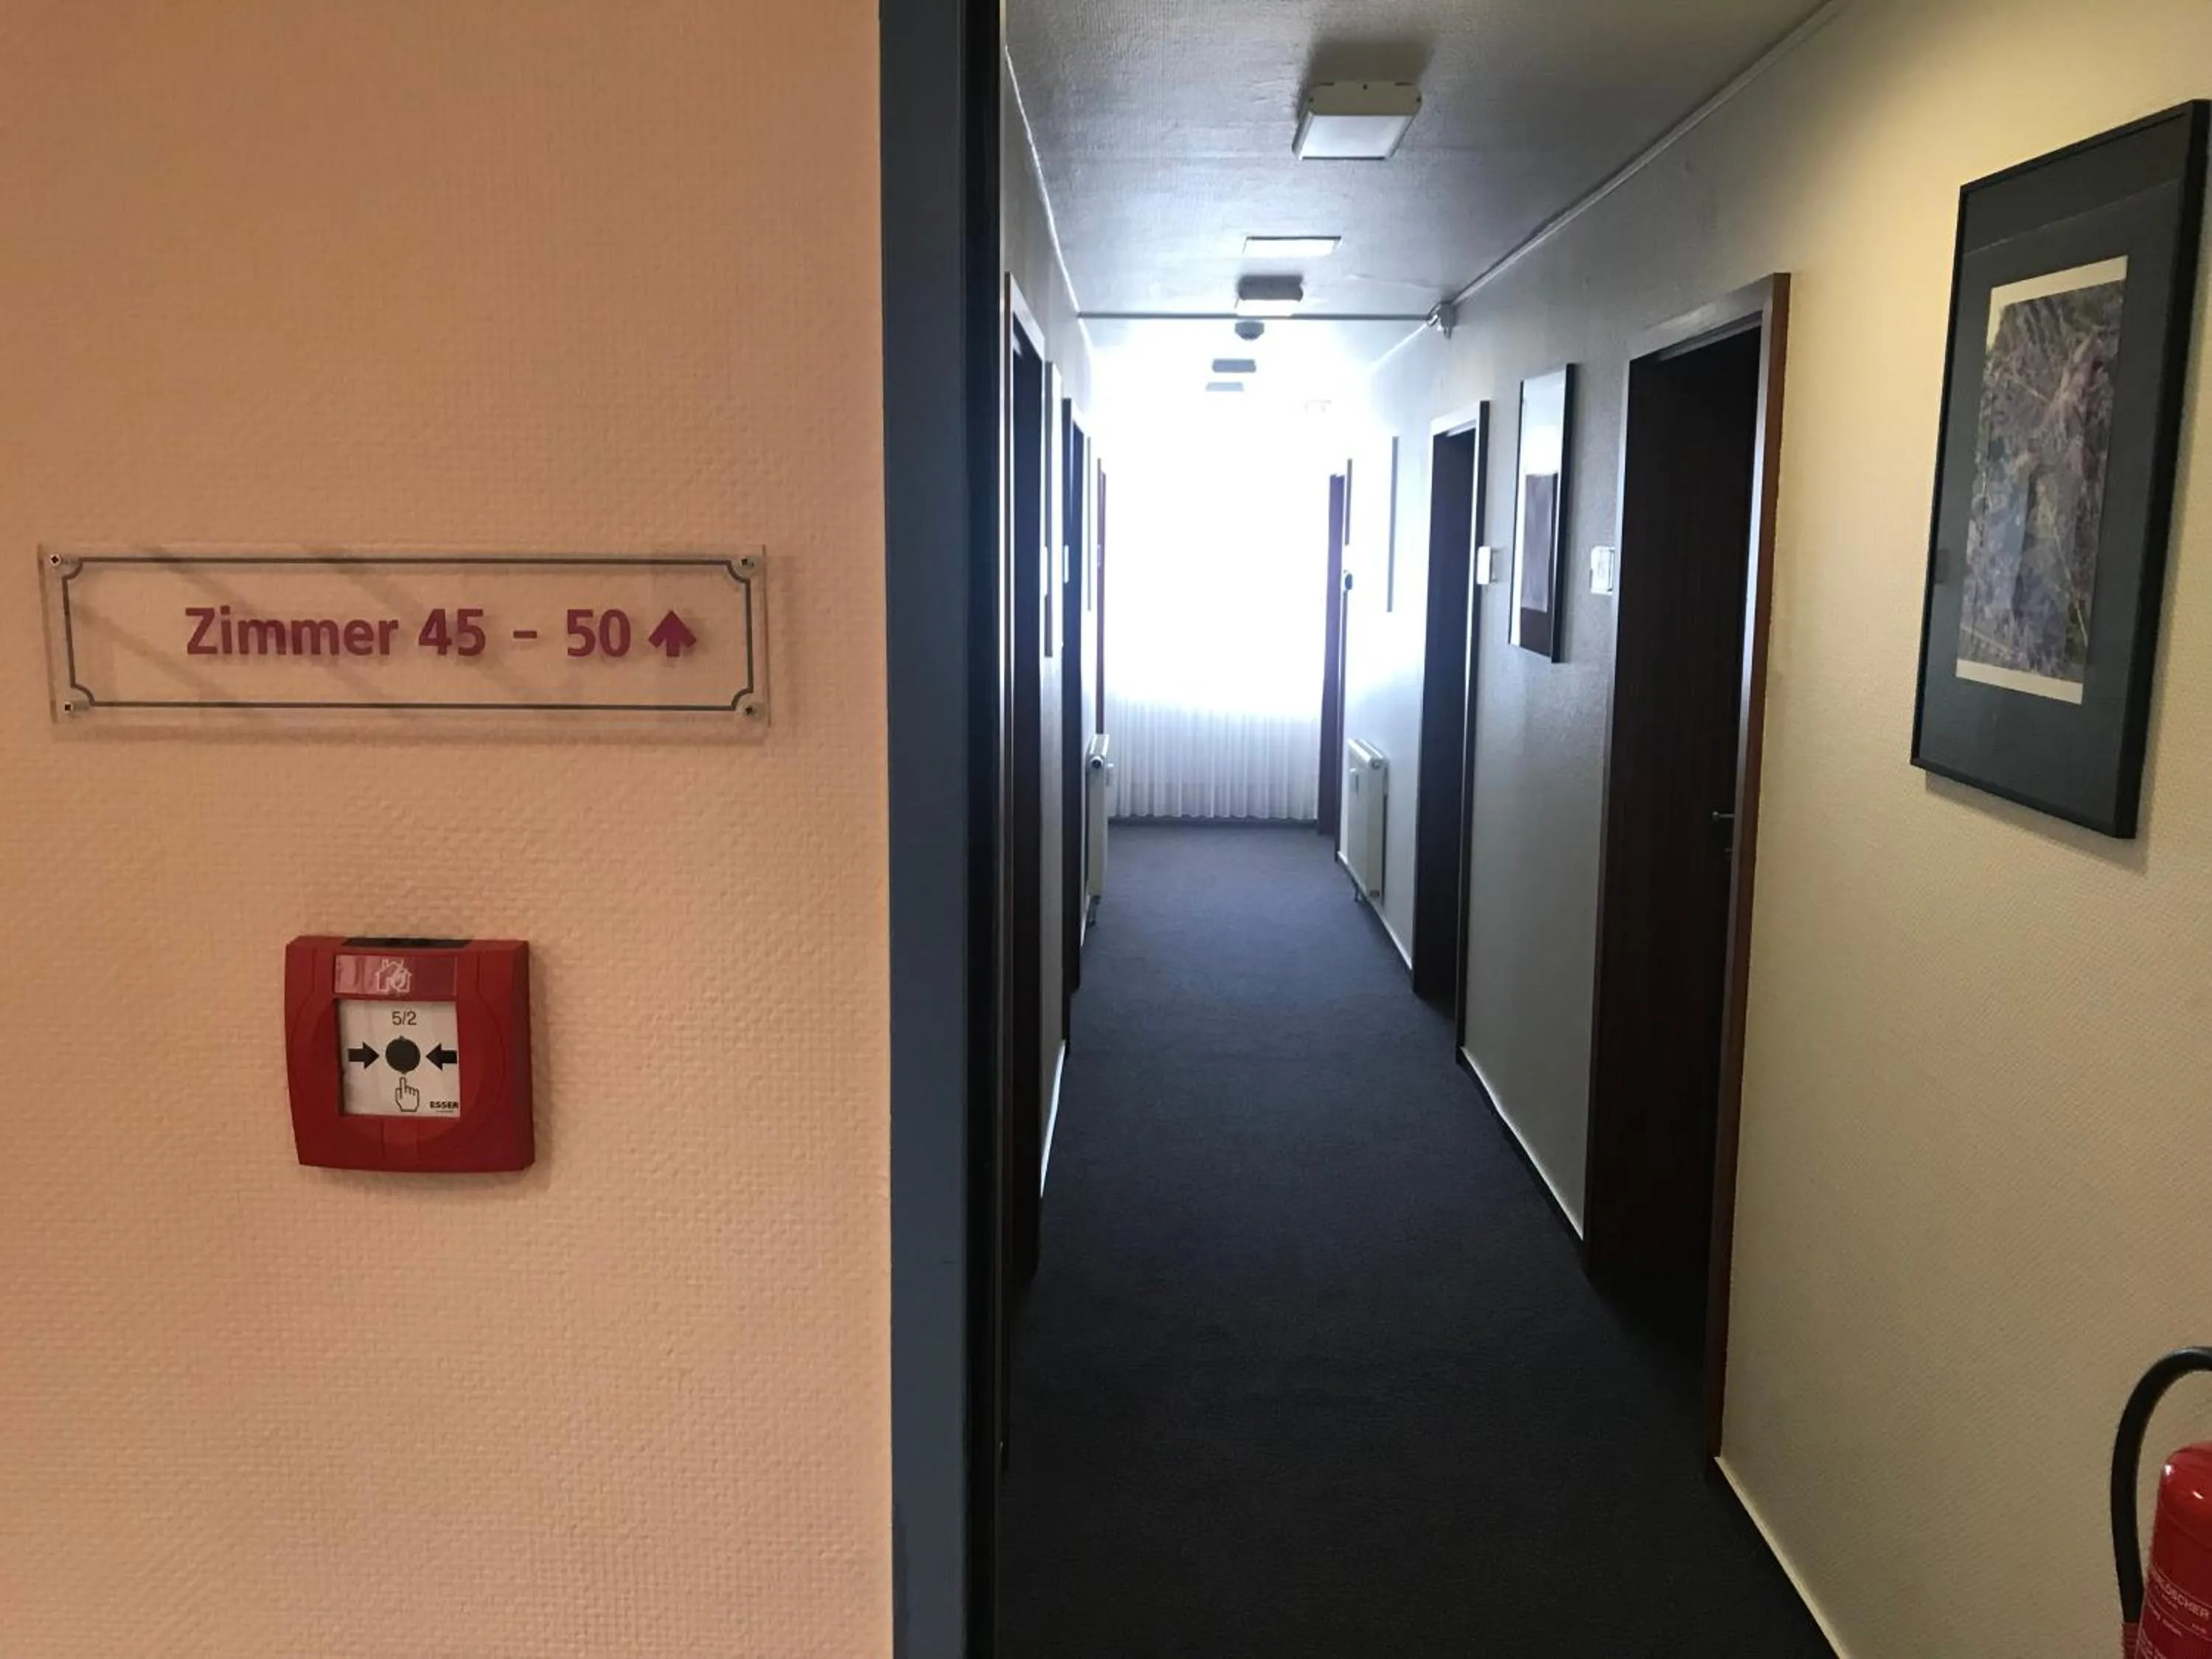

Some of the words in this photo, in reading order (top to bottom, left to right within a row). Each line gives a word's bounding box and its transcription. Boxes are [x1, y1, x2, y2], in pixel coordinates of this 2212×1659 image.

[184, 605, 400, 656] Zimmer
[418, 608, 487, 657] 45
[513, 629, 538, 639] -
[566, 609, 632, 658] 50
[392, 1011, 417, 1026] 5/2
[430, 1101, 459, 1109] ESSER
